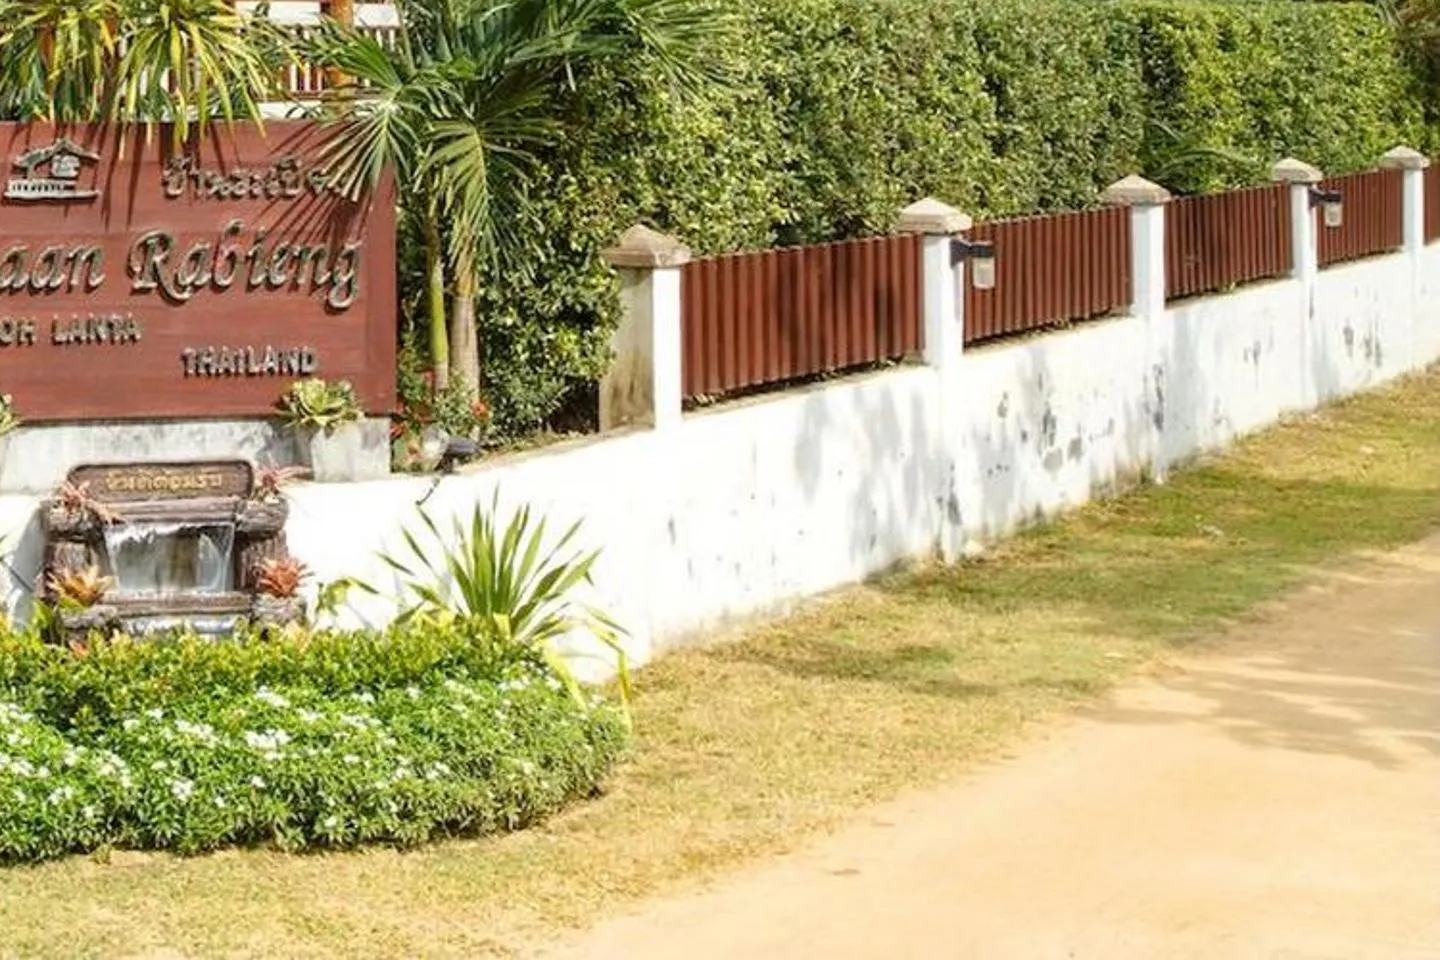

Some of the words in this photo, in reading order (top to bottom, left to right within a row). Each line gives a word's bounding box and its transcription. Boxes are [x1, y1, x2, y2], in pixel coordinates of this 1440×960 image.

[128, 218, 363, 309] Rabieng
[51, 312, 142, 345] LANTA
[181, 345, 318, 377] THAILAND
